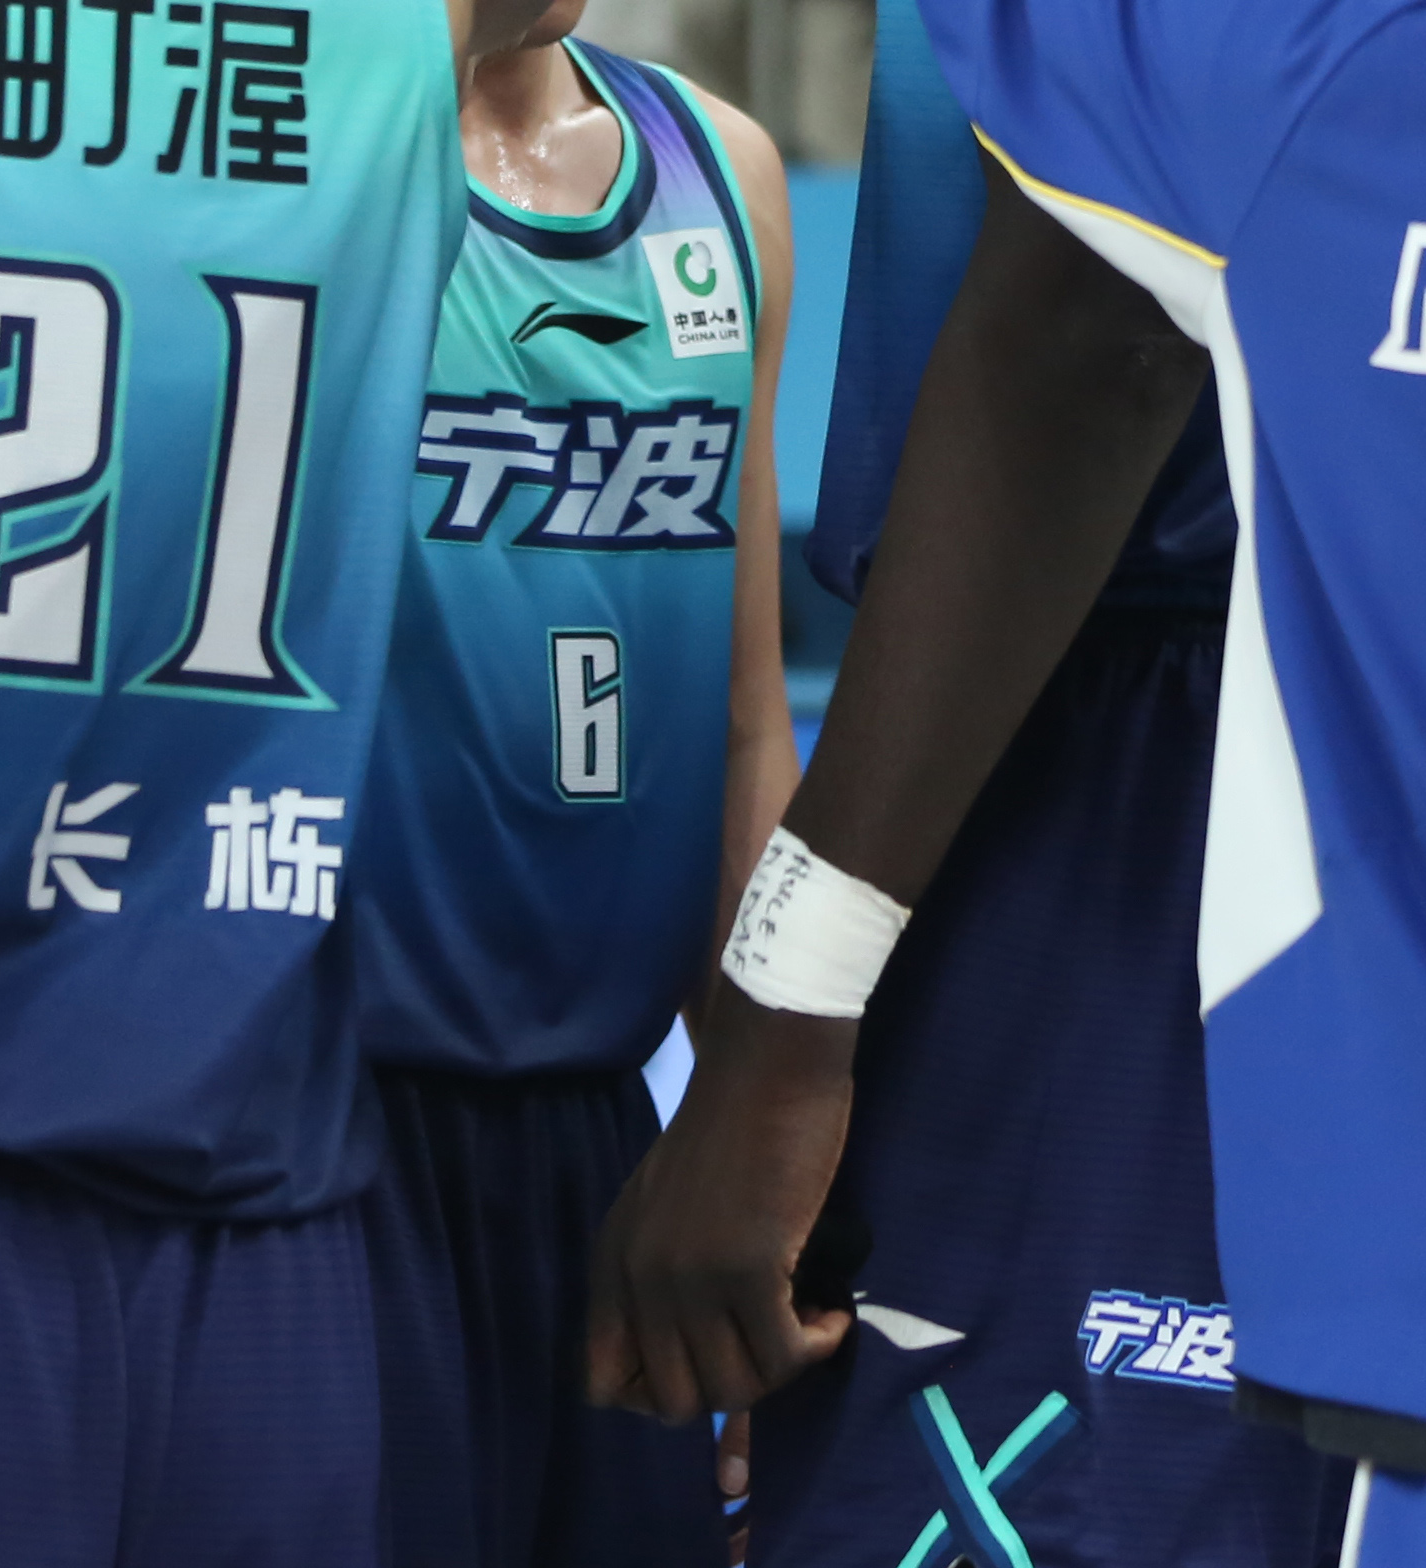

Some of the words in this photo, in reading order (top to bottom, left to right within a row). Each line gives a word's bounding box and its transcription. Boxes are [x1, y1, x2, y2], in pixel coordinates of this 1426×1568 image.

[677, 330, 717, 345] CHINA
[719, 328, 741, 341] LIFE
[418, 405, 733, 538] 宁波
[550, 632, 623, 799] 6
[1081, 1296, 1237, 1384] 宁波
